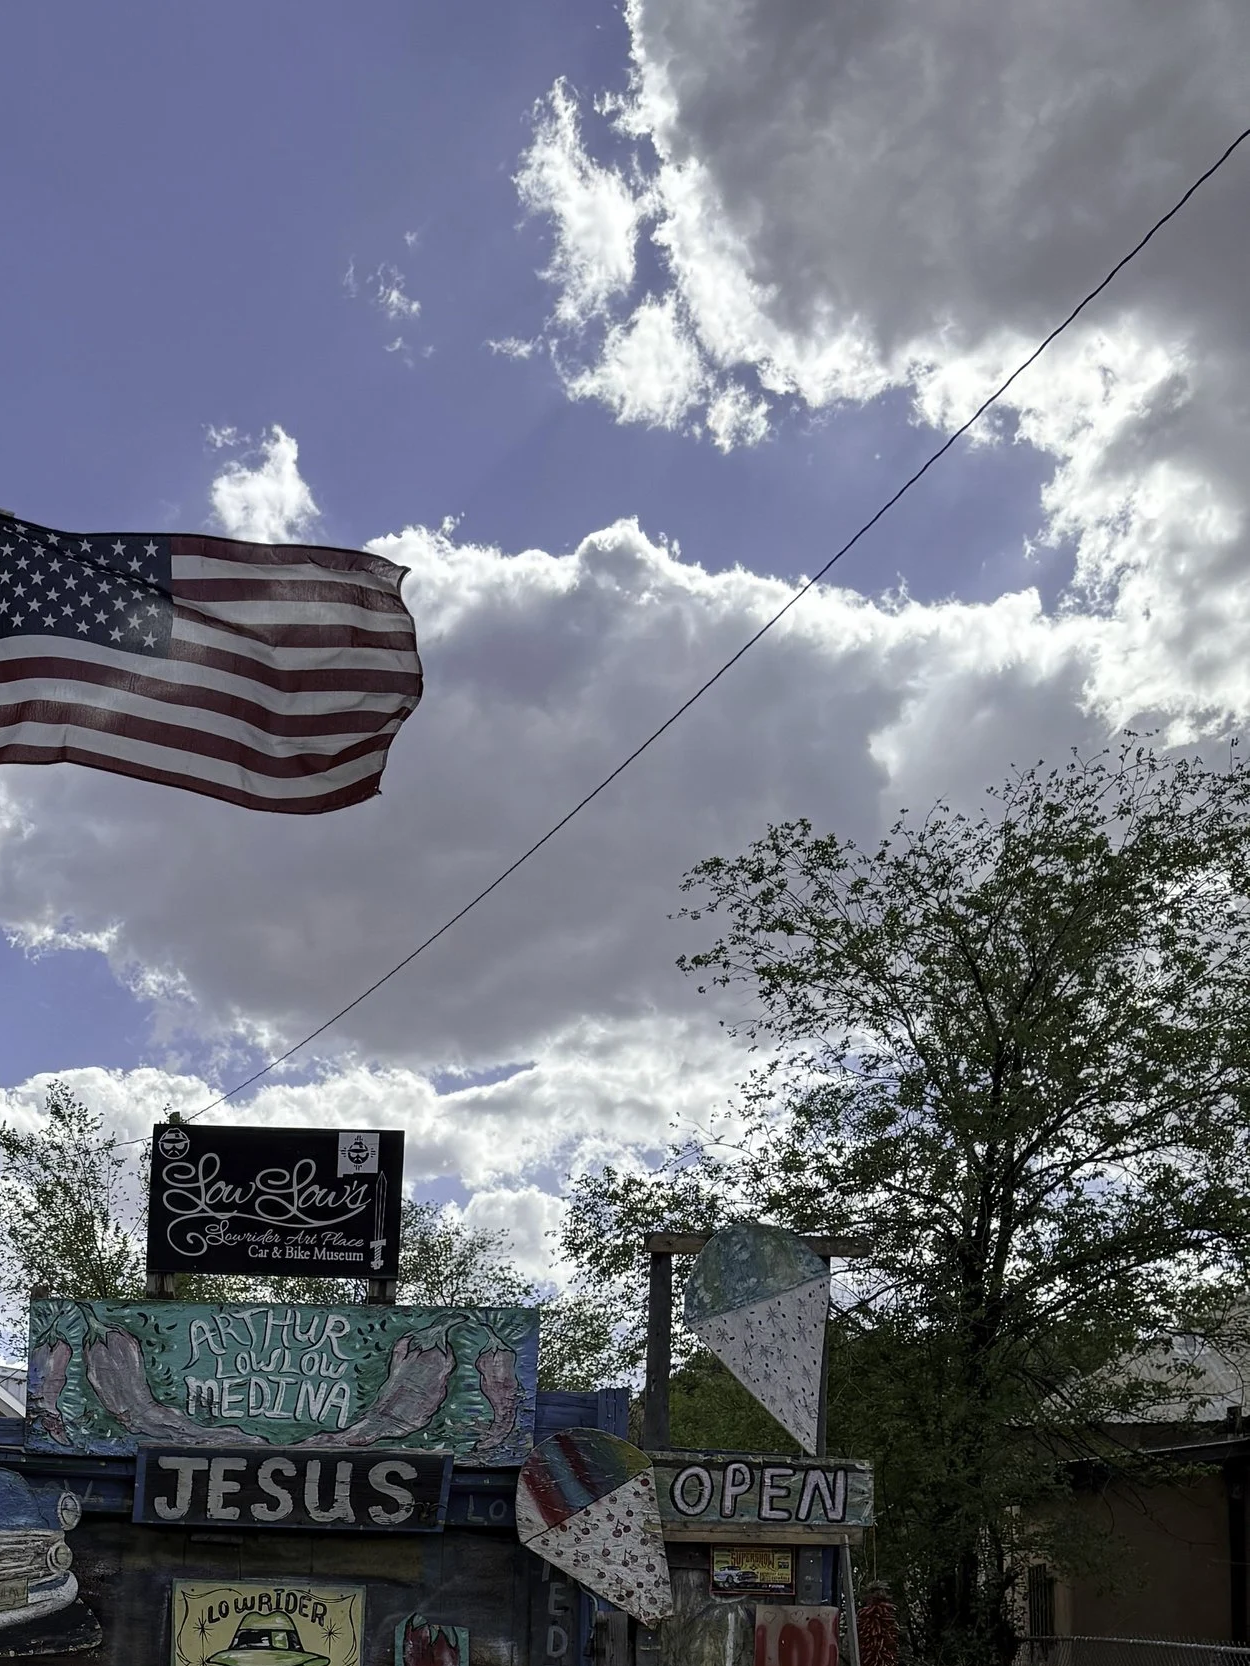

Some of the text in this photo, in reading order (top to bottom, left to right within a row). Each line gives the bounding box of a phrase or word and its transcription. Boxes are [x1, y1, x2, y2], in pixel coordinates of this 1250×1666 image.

[162, 1153, 372, 1227] Low Low's
[205, 1220, 364, 1247] Lowrider Art Place
[248, 1246, 364, 1261] Car & Bike Museum
[181, 1308, 354, 1370] ARTHUR
[184, 1376, 351, 1429] MEDINA
[153, 1456, 418, 1525] JESUS
[670, 1460, 848, 1523] OPEN
[207, 1588, 328, 1627] LOWRIDER
